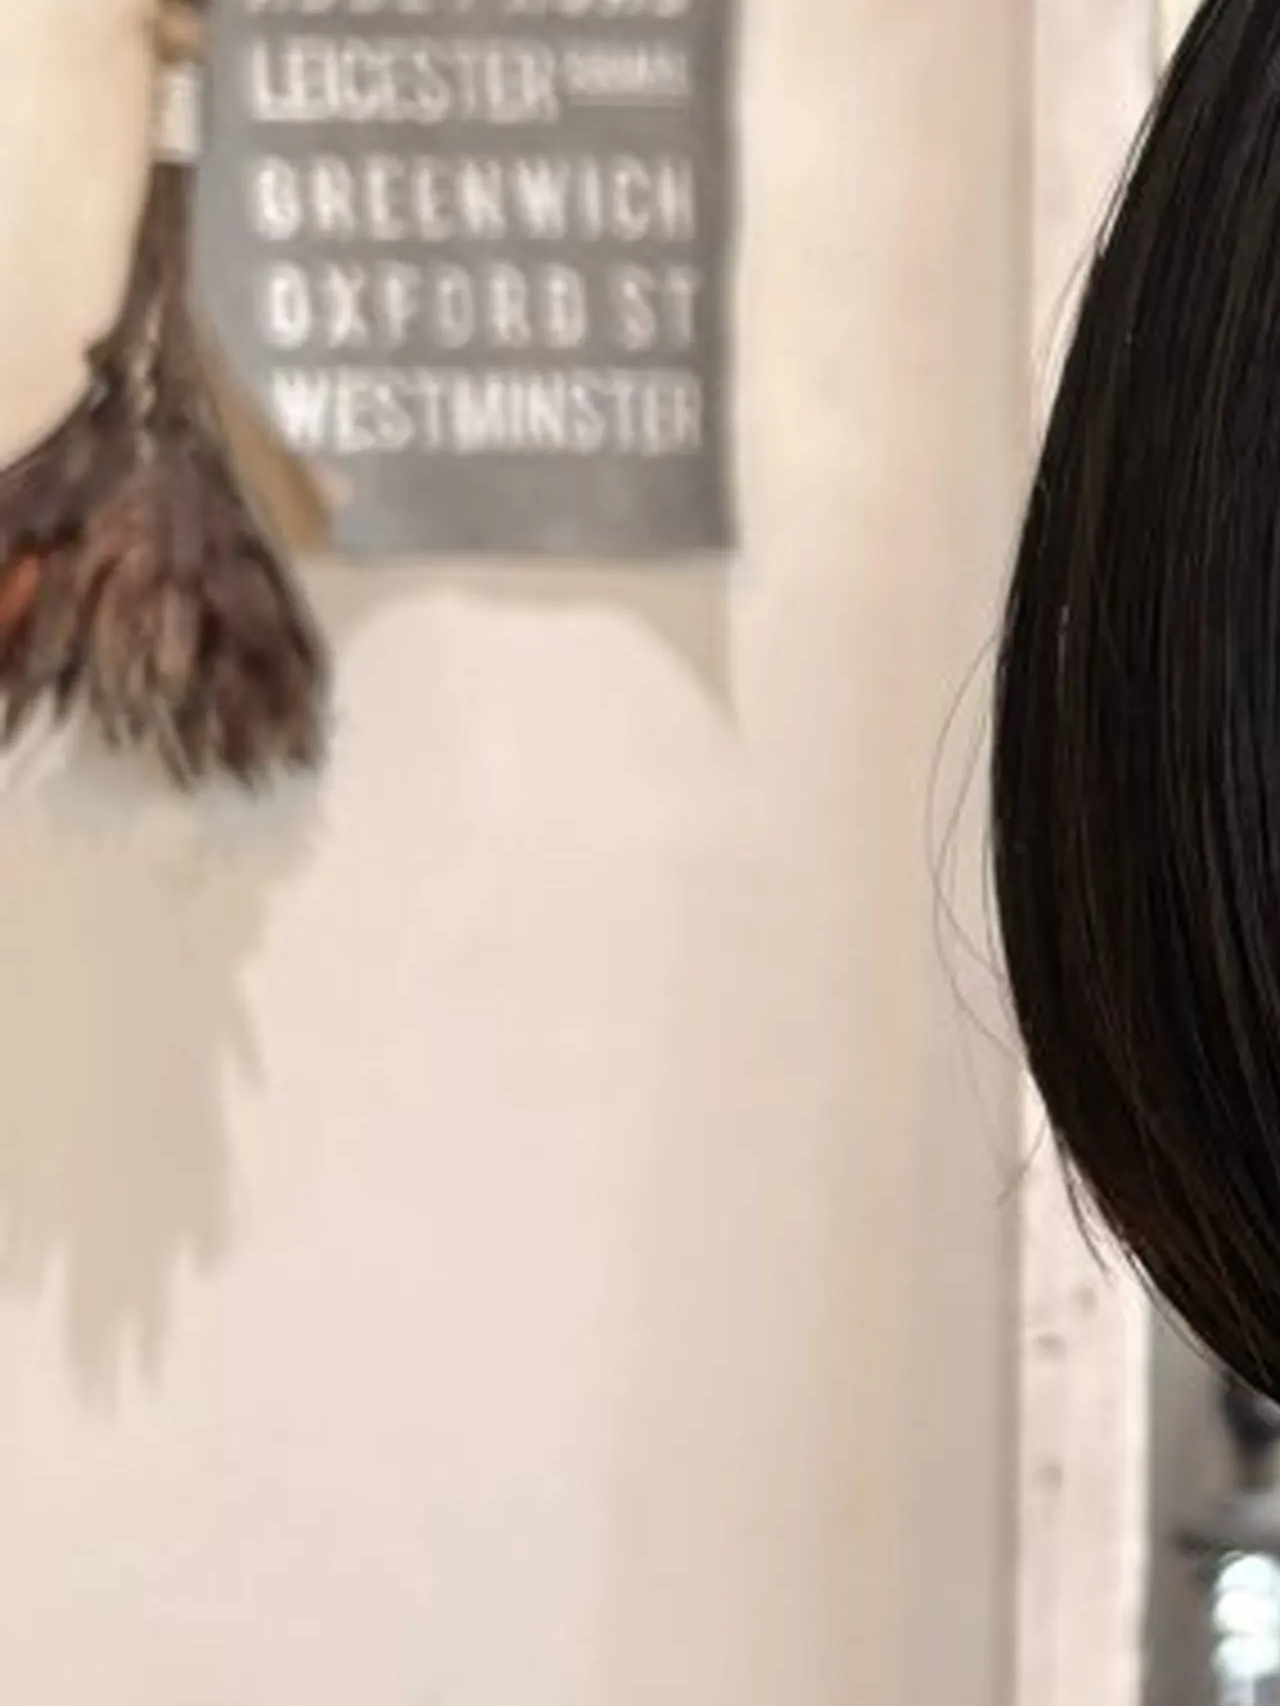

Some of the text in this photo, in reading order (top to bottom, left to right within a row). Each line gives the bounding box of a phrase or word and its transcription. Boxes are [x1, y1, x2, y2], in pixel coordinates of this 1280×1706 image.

[251, 35, 560, 124] LEICESTER
[254, 154, 697, 243] GREENWICH
[265, 261, 703, 351] OXFORD ST
[269, 364, 705, 456] WESTMINSTER
